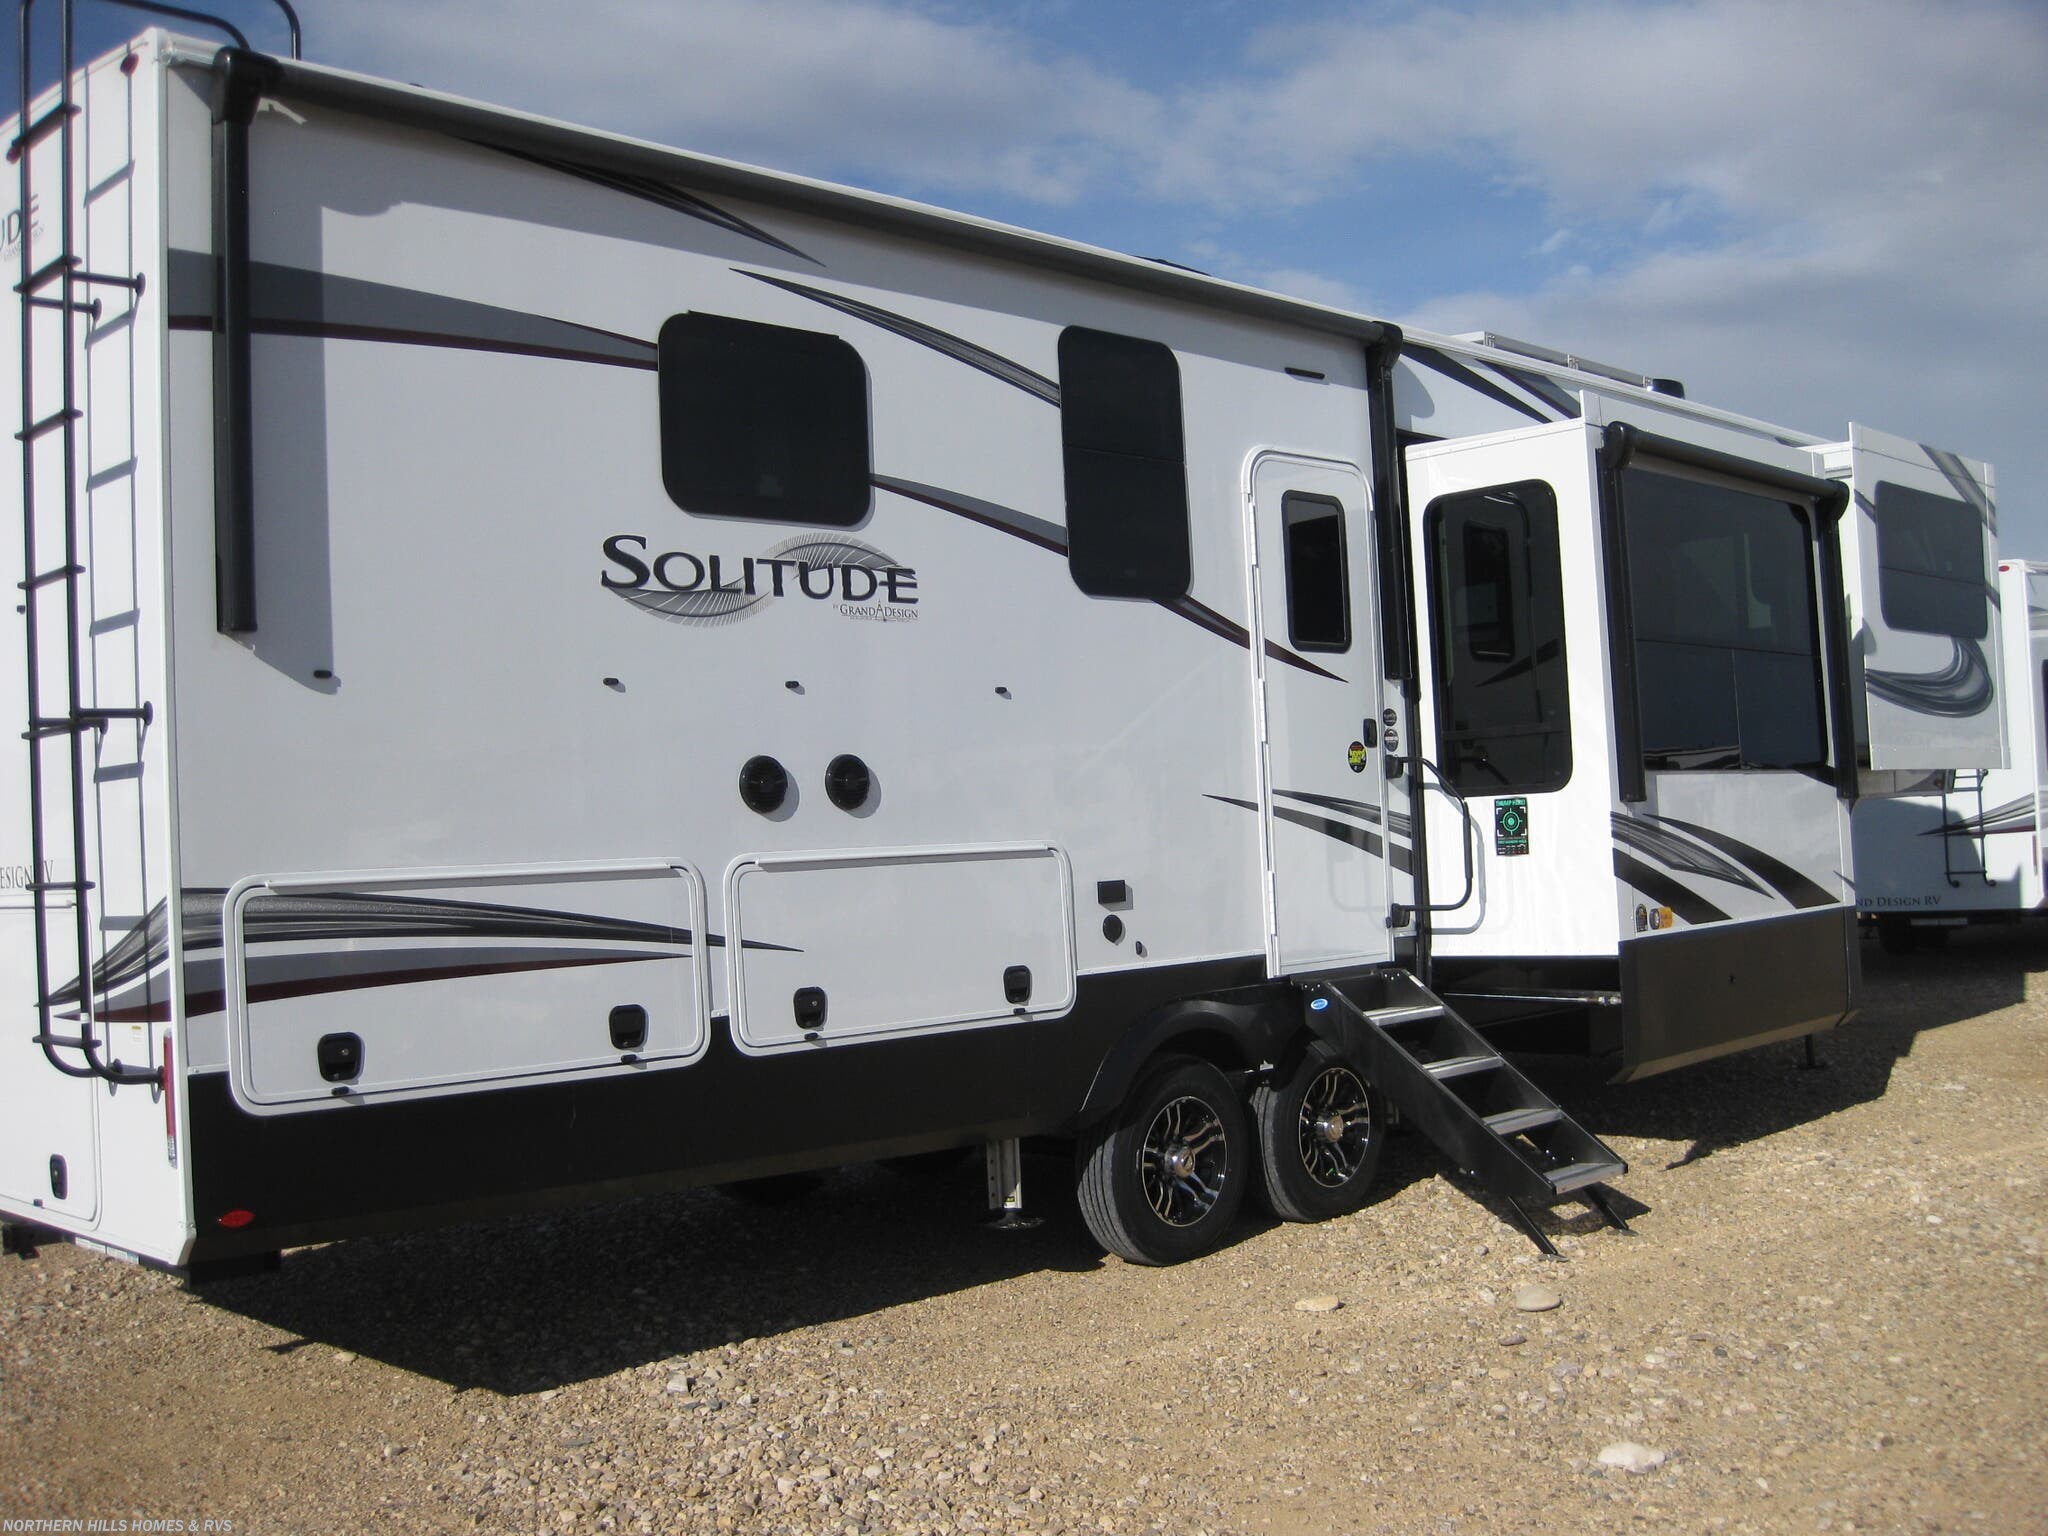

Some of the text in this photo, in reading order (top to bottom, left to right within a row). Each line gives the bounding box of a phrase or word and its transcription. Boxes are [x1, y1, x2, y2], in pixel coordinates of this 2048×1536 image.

[601, 534, 919, 604] SOLITUDE
[884, 606, 918, 618] DESIGN
[1877, 896, 1920, 907] DESIGN
[1924, 895, 1942, 905] RV
